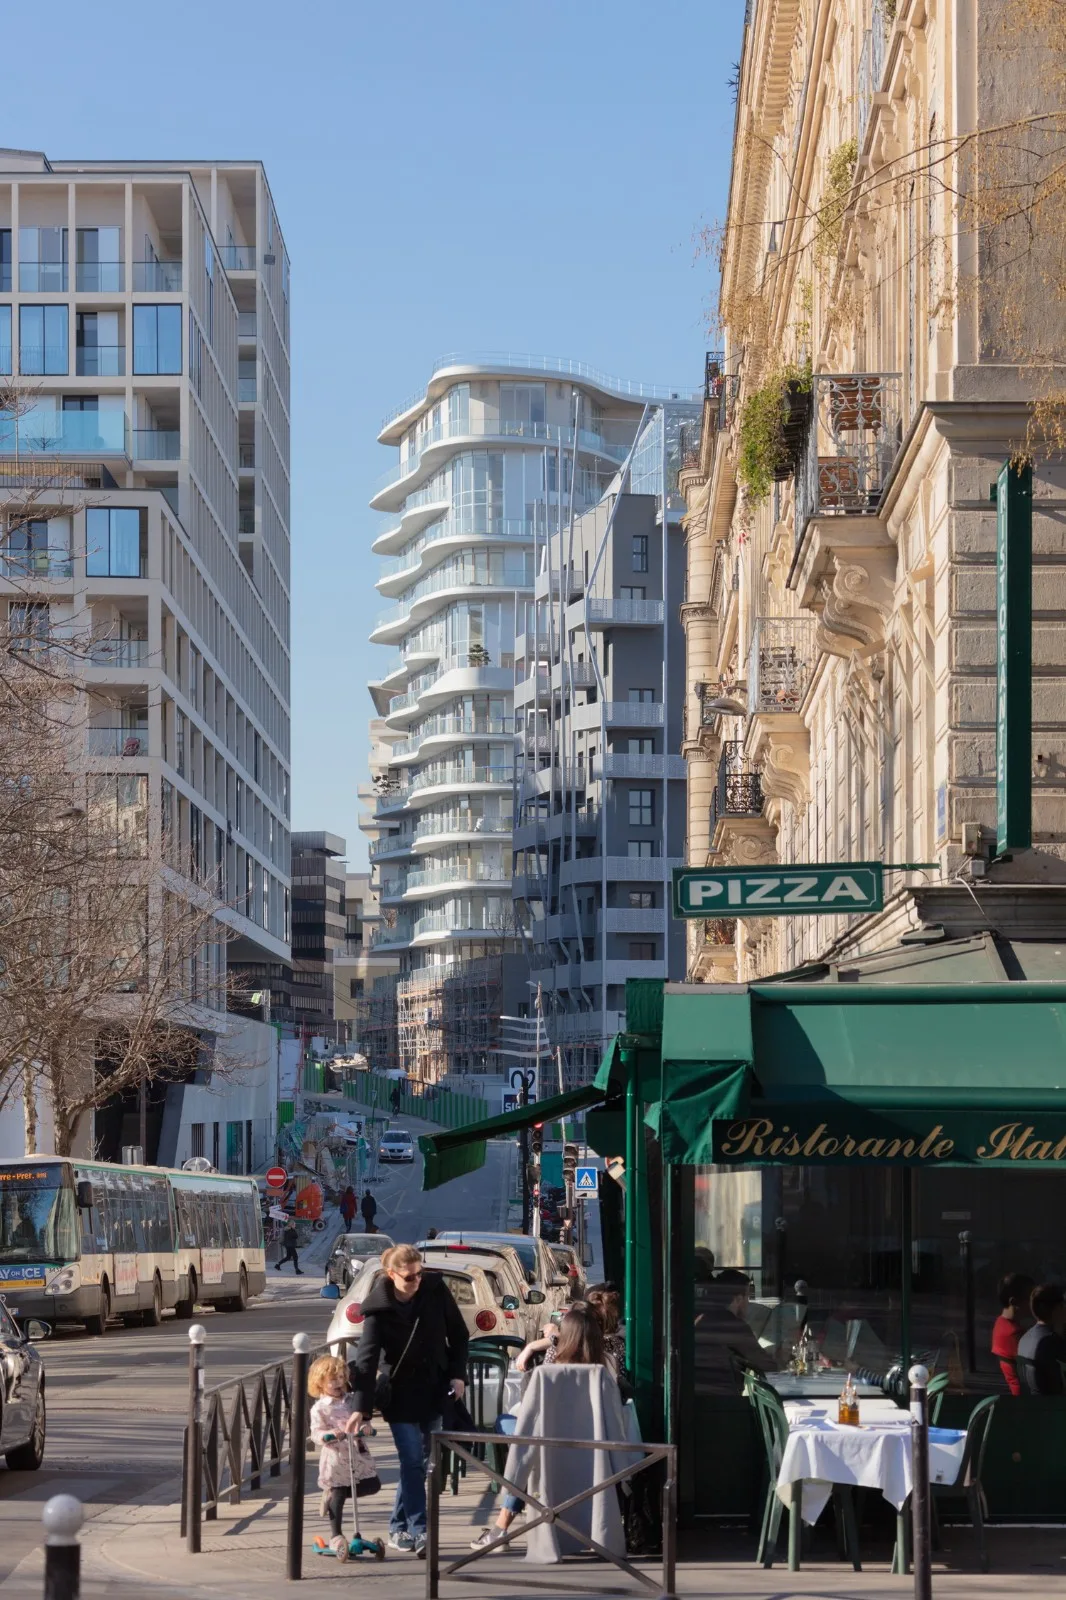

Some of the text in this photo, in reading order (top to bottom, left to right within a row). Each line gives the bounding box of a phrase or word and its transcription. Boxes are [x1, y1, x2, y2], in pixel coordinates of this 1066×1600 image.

[998, 483, 1007, 783] RISTORANTE
[689, 876, 868, 906] PIZZA
[721, 1118, 954, 1158] Ristorante
[22, 1267, 42, 1279] ICE
